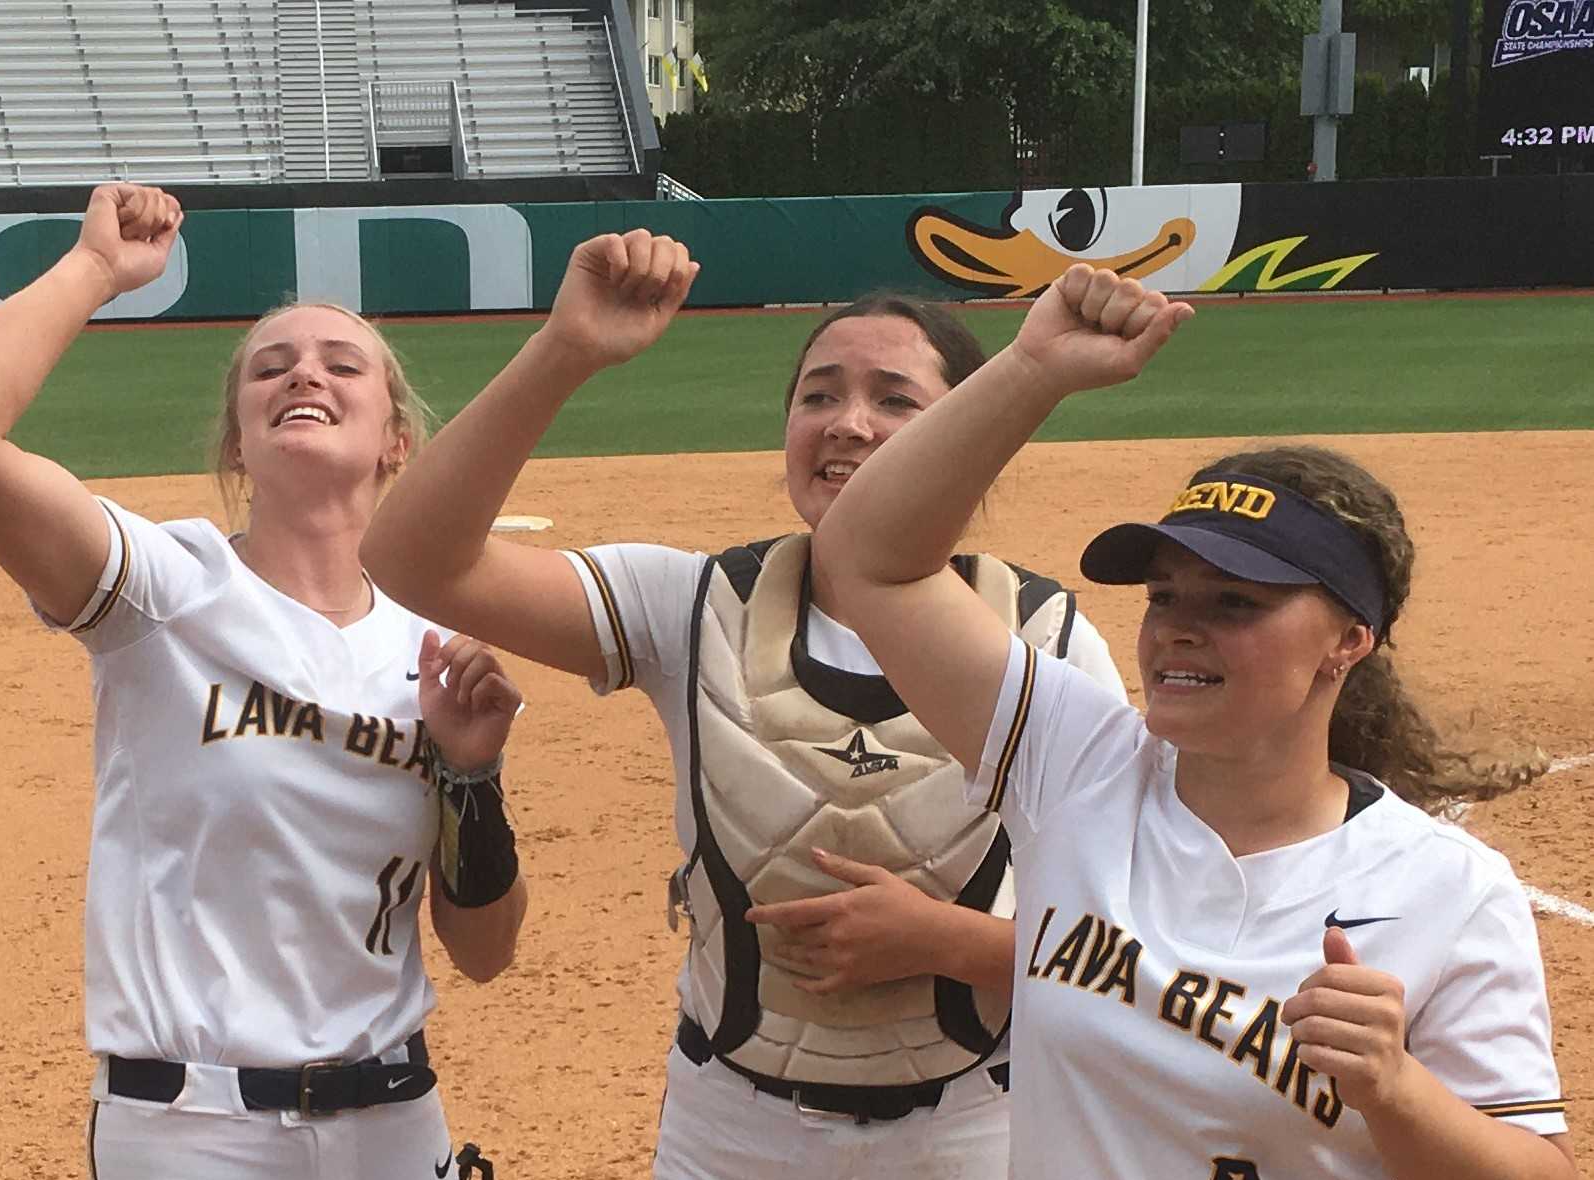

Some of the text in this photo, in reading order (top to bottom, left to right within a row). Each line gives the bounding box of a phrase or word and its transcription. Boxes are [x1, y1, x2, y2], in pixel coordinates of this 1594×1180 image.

[1501, 126, 1594, 146] 4:32 PM
[200, 681, 327, 747] LAVA
[364, 855, 422, 956] 11
[1026, 905, 1144, 1007] LAVA
